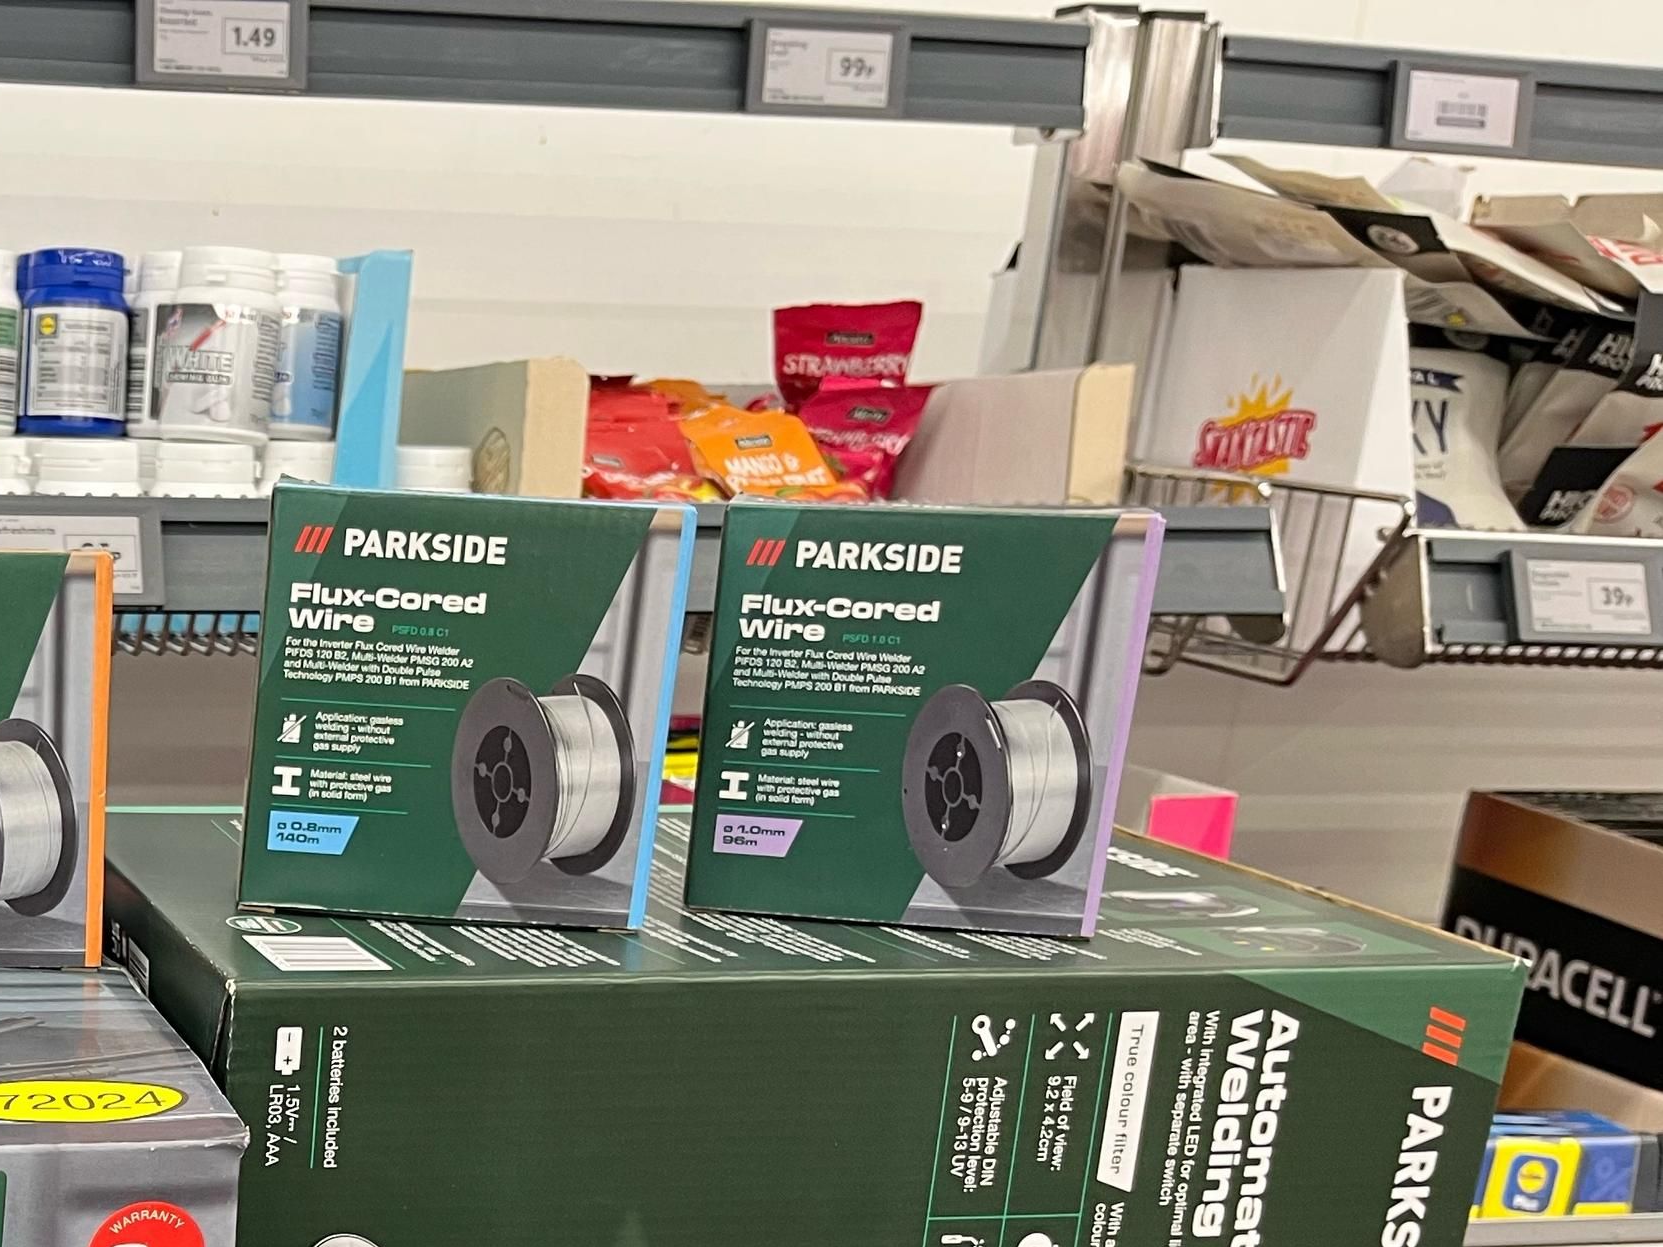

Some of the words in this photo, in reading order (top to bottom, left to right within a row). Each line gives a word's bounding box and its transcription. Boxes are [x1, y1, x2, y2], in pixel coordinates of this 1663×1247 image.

[233, 26, 275, 47] 1.49
[343, 527, 508, 566] PARKSIDE
[796, 540, 963, 574] PARKSIDE
[290, 582, 487, 615] Flux-Cored
[741, 594, 940, 623] Flux-Cored
[288, 608, 375, 633] Wire
[739, 618, 826, 642] Wire
[276, 832, 320, 845] 140m
[291, 821, 342, 834] 0.8mm
[722, 835, 758, 846] 96m
[737, 824, 786, 837] 1.0mm
[333, 1026, 348, 1037] 2
[1185, 1011, 1200, 1044] area
[1202, 1010, 1220, 1045] With
[1125, 1023, 1145, 1067] True
[328, 1040, 347, 1104] batteries
[1045, 1075, 1061, 1099] 9.2
[1178, 1058, 1193, 1089] with
[1189, 1049, 1214, 1122] integrated
[266, 1085, 284, 1128] LR03,
[960, 1077, 976, 1103] 5-9
[1059, 1075, 1078, 1111] Field
[1116, 1071, 1135, 1128] colour
[969, 1077, 989, 1152] protection
[984, 1076, 1008, 1155] Adjustable
[1057, 1115, 1070, 1131] of
[1167, 1092, 1187, 1157] separate
[1192, 1009, 1264, 1238] Welding
[265, 1132, 281, 1167] AAA
[324, 1107, 342, 1168] included
[954, 1117, 970, 1151] 9-13
[1037, 1116, 1055, 1162] 4.2cm
[1184, 1125, 1201, 1157] LED
[950, 1155, 966, 1177] UV
[1050, 1134, 1067, 1171] view:
[1110, 1133, 1127, 1175] filter
[1179, 1159, 1195, 1180] for
[963, 1155, 982, 1192] level:
[980, 1158, 996, 1186] DIN
[1158, 1159, 1176, 1206] switch
[110, 1209, 185, 1234] WARRANTY
[1105, 1202, 1125, 1236] With
[1169, 1183, 1189, 1236] optimal
